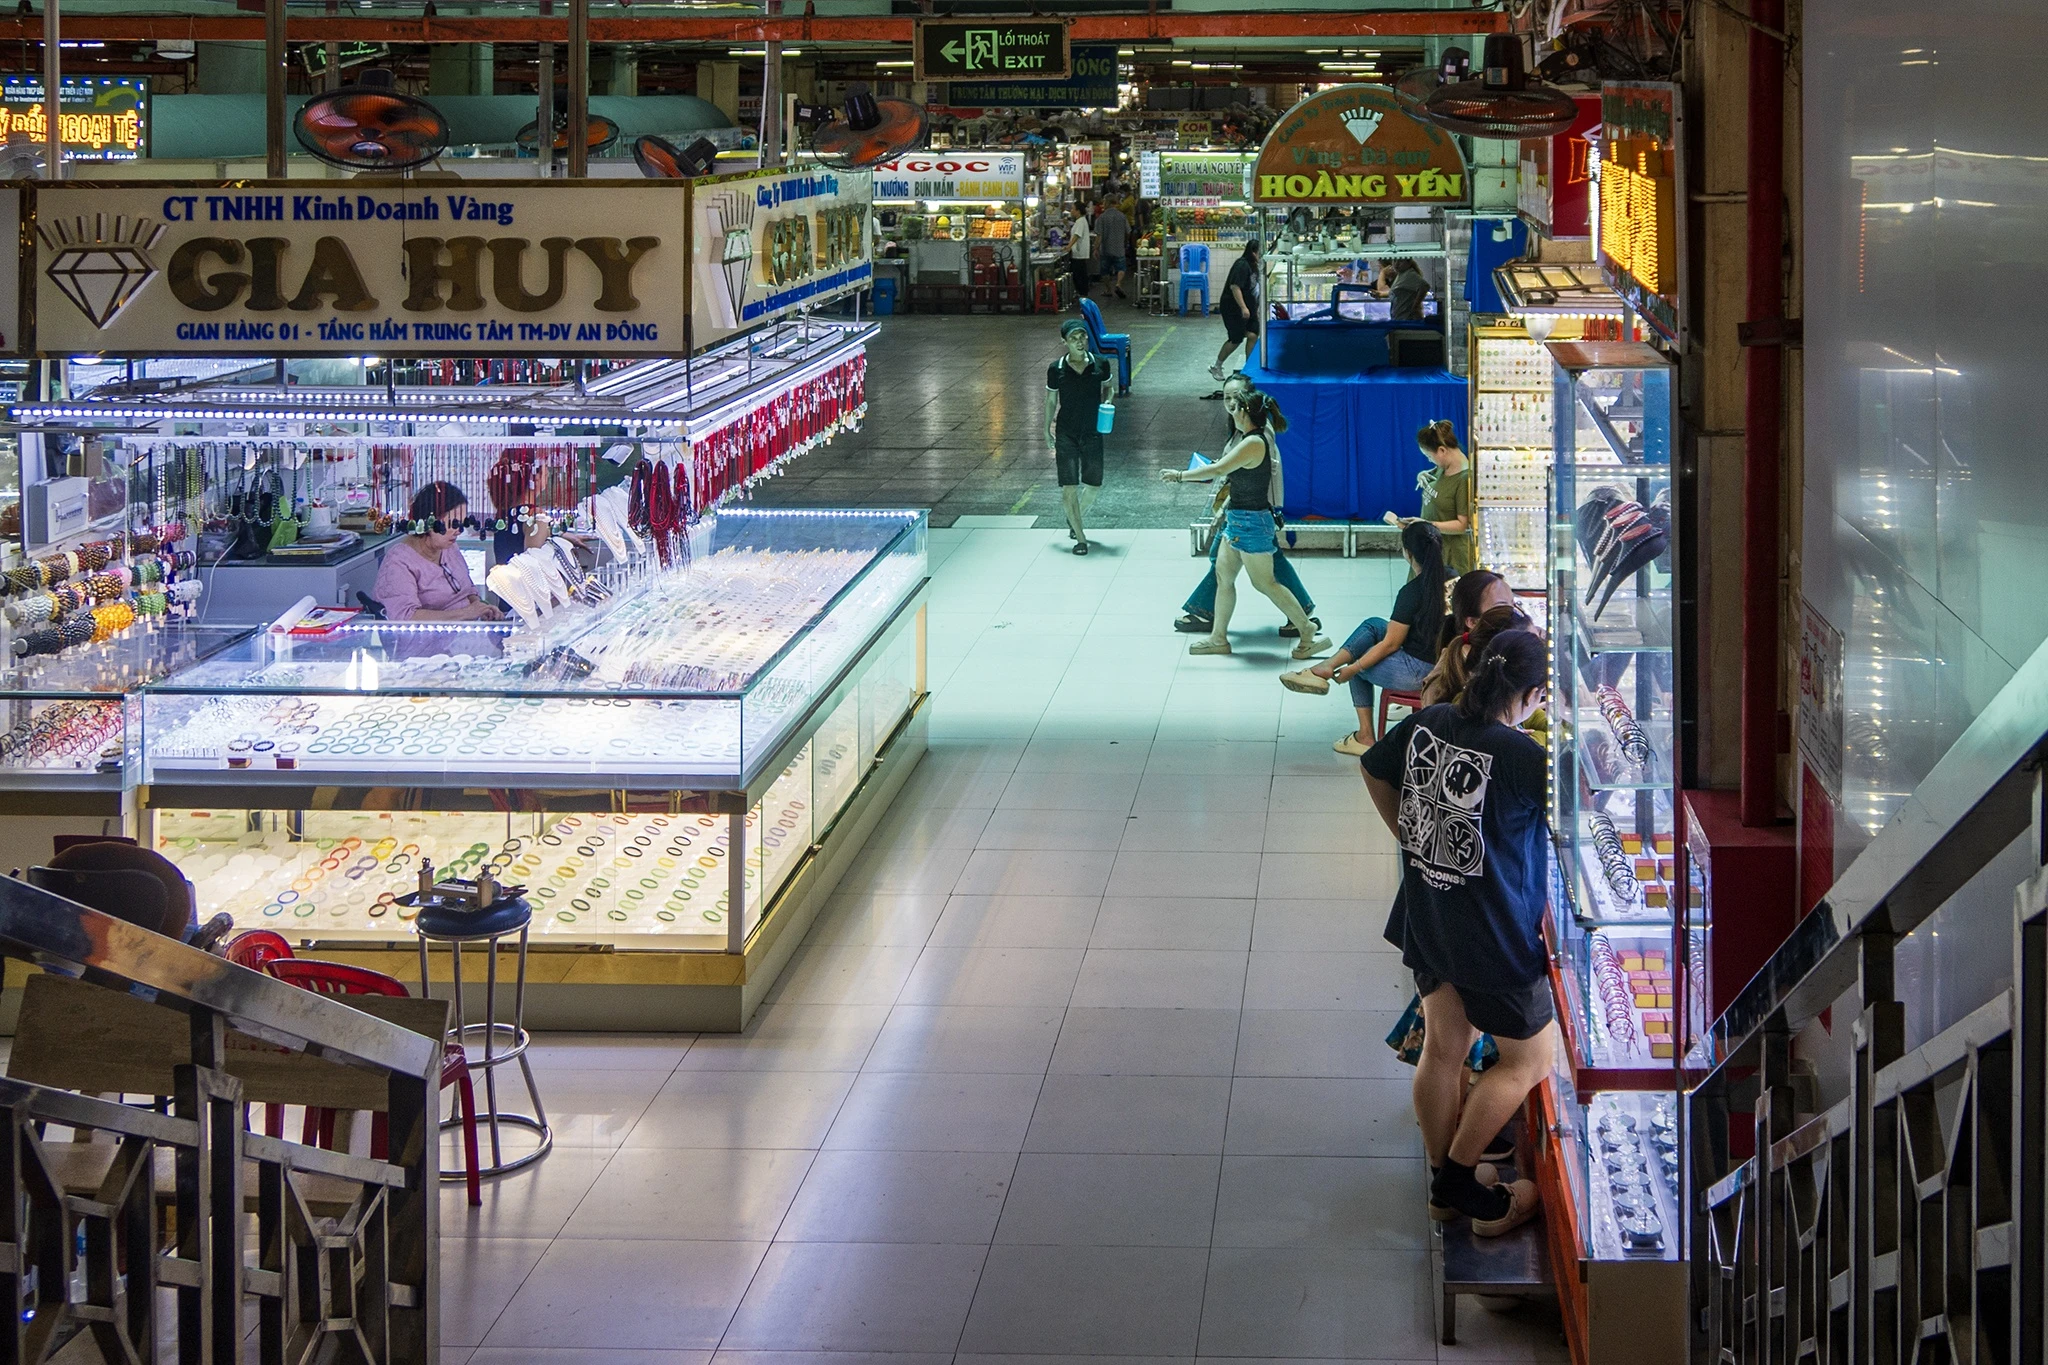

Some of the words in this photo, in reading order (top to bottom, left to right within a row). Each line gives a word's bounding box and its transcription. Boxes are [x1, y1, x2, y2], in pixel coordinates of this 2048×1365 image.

[1000, 29, 1016, 46] LỐI
[1018, 31, 1050, 46] THOÁT
[1005, 56, 1046, 69] EXIT
[114, 110, 139, 149] TỆ
[1291, 147, 1343, 168] Vàng
[1361, 147, 1387, 165] Đá
[1073, 166, 1091, 187] TẤM
[1175, 163, 1192, 174] RAU
[881, 177, 909, 197] NƯỚNG
[915, 179, 931, 197] BÚN
[982, 181, 1002, 197] CANH
[1260, 170, 1387, 198] HOÀNG
[1395, 168, 1463, 198] YẾN
[163, 196, 199, 221] CT
[205, 196, 284, 221] TNHH
[293, 195, 354, 221] Kinh
[357, 196, 439, 221] Doanh
[447, 196, 514, 226] Vàng
[168, 236, 380, 312] GIA
[402, 236, 662, 313] HUY
[176, 323, 220, 342] GIAN
[225, 319, 274, 342] HÀNG
[279, 323, 299, 341] 01
[413, 323, 472, 341] TRUNG
[477, 320, 514, 341] TÂM
[518, 323, 573, 341] TM-DV
[576, 323, 601, 341] AN
[606, 320, 658, 341] ĐÔNG
